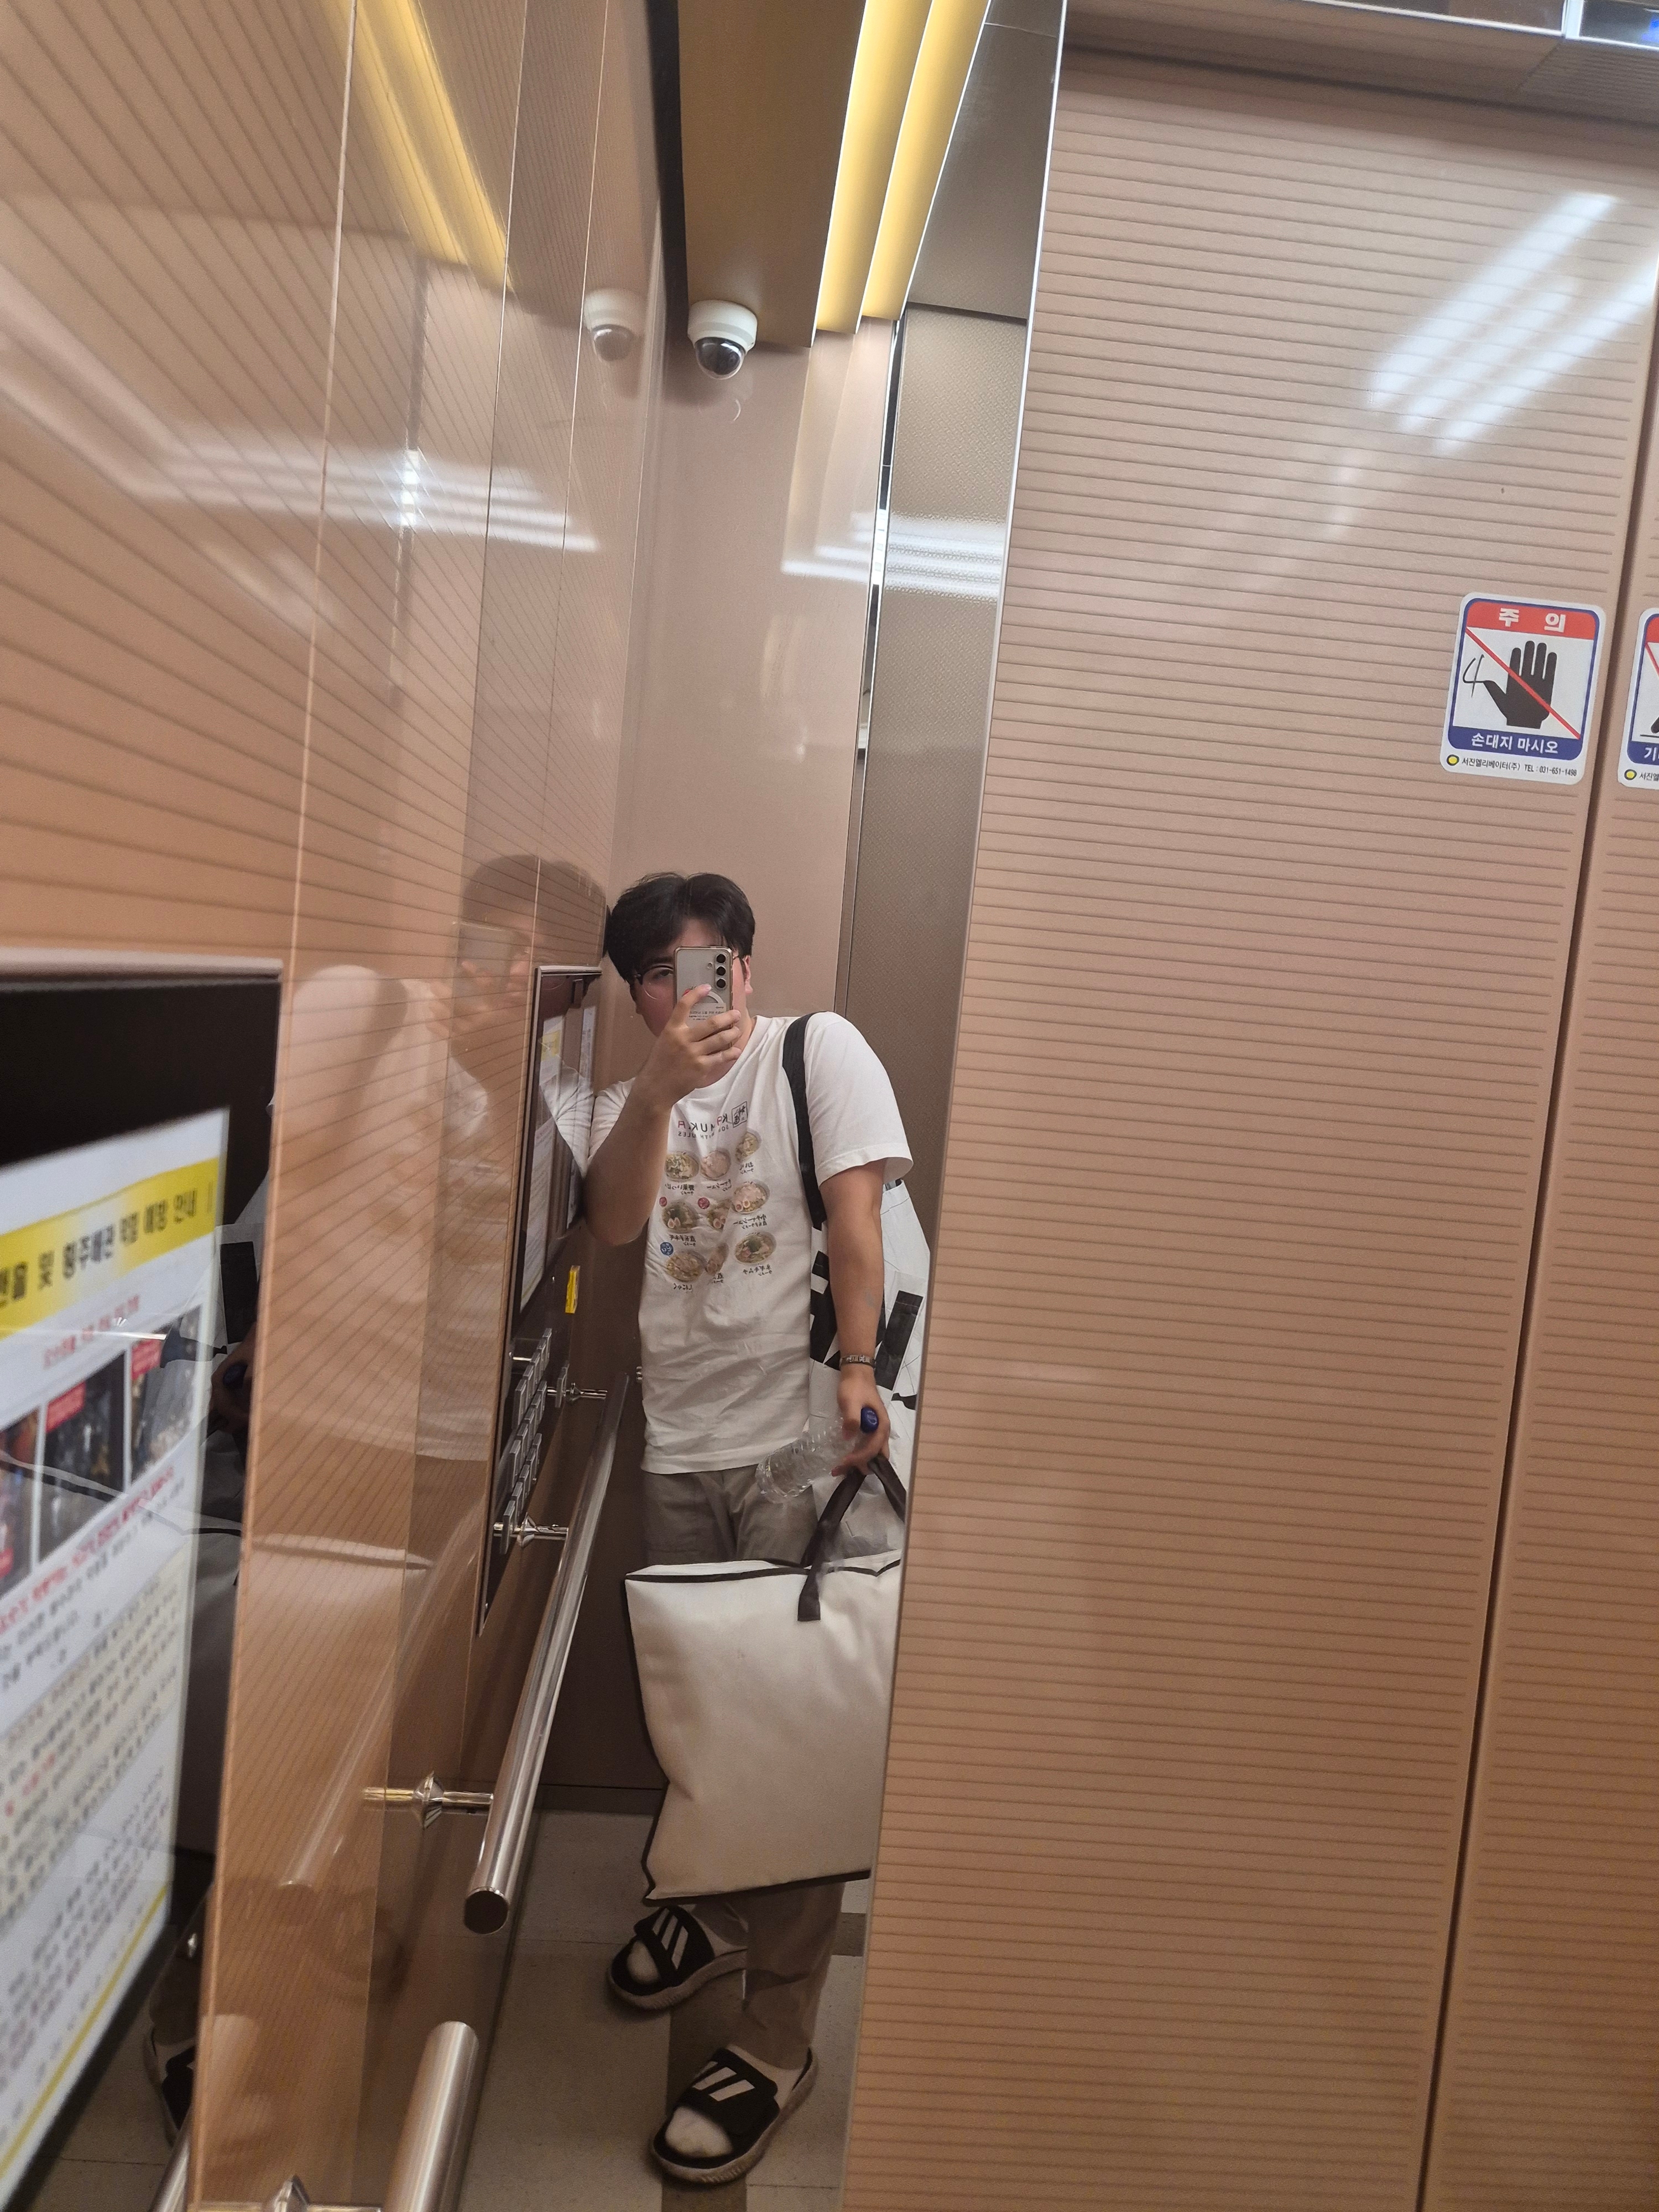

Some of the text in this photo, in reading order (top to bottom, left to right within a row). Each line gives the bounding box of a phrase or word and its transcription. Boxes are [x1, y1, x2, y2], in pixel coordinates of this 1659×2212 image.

[1471, 733, 1558, 754] 손대지 마시오
[1462, 757, 1520, 771] 서진엘리베이터(주)
